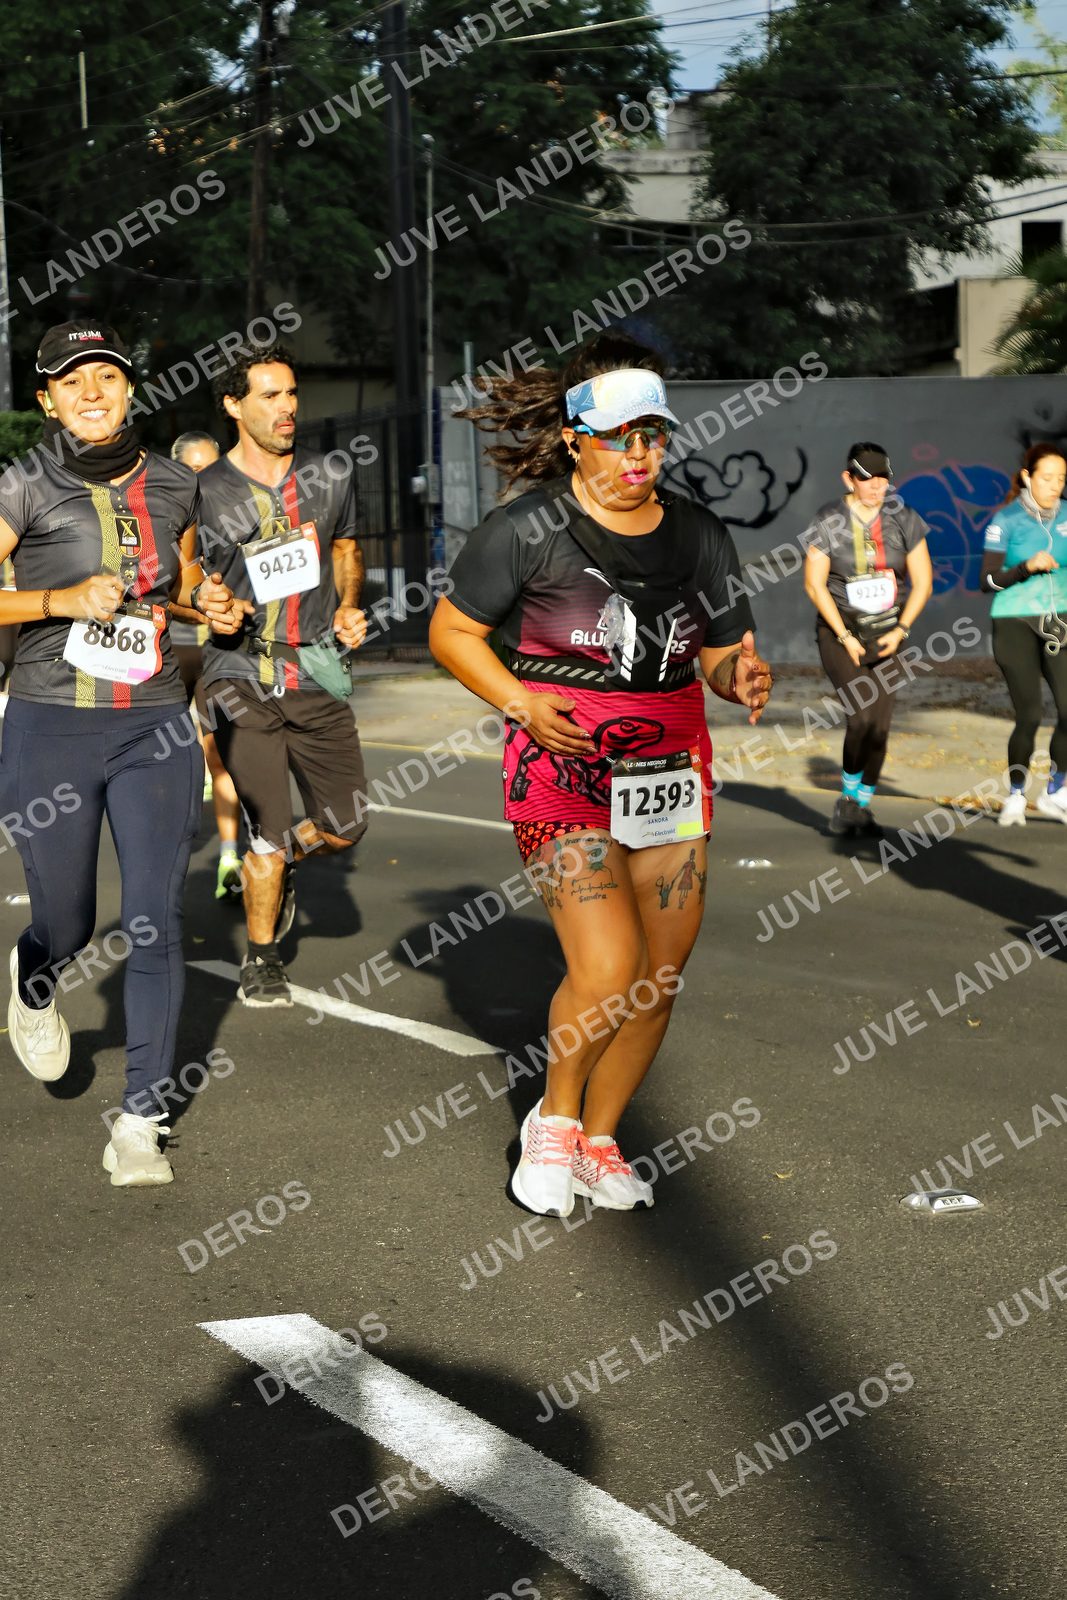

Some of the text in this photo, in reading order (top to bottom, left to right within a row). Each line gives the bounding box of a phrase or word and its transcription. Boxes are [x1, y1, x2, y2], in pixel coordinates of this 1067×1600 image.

[260, 548, 308, 580] 9423
[83, 620, 146, 654] 8868
[617, 779, 695, 817] 12593
